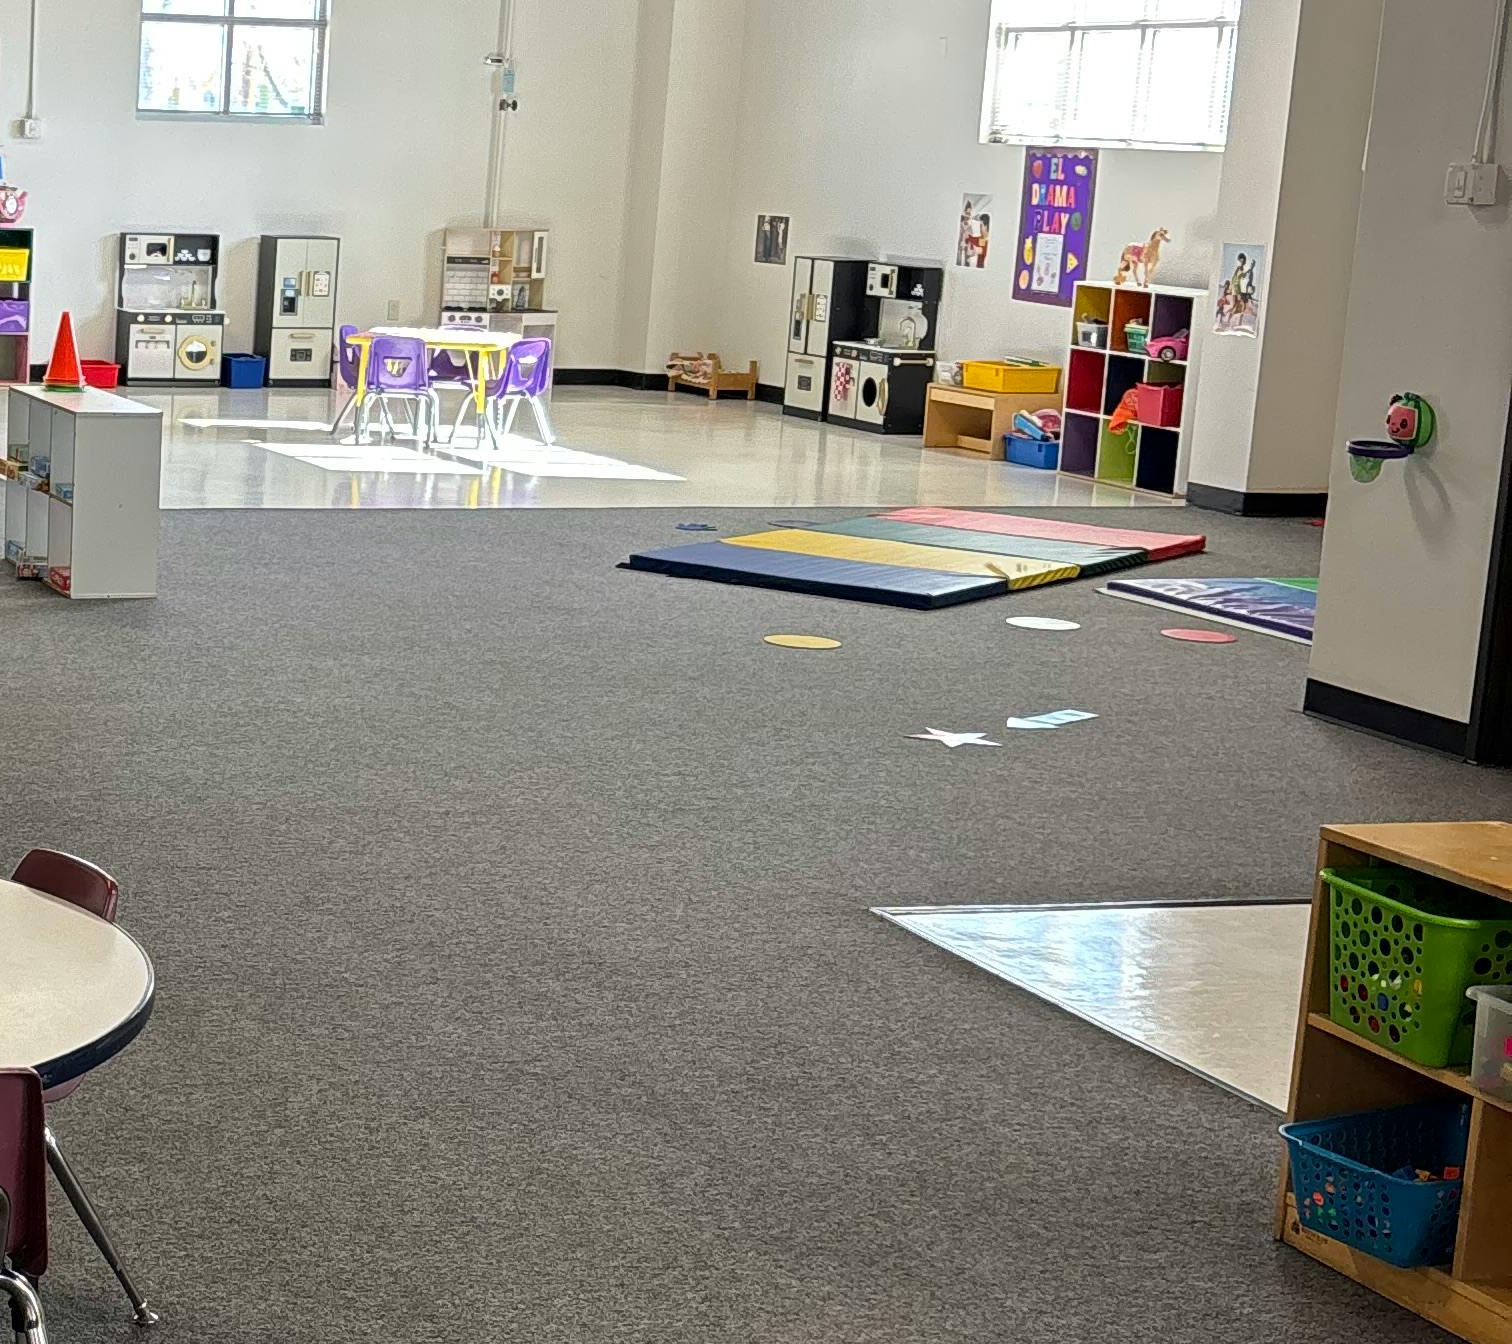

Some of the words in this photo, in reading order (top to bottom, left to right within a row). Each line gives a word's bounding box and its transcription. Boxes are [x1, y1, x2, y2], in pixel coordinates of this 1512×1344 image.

[1049, 157, 1065, 180] EL
[1031, 183, 1076, 208] DRAMA
[1033, 209, 1069, 234] PLAY
